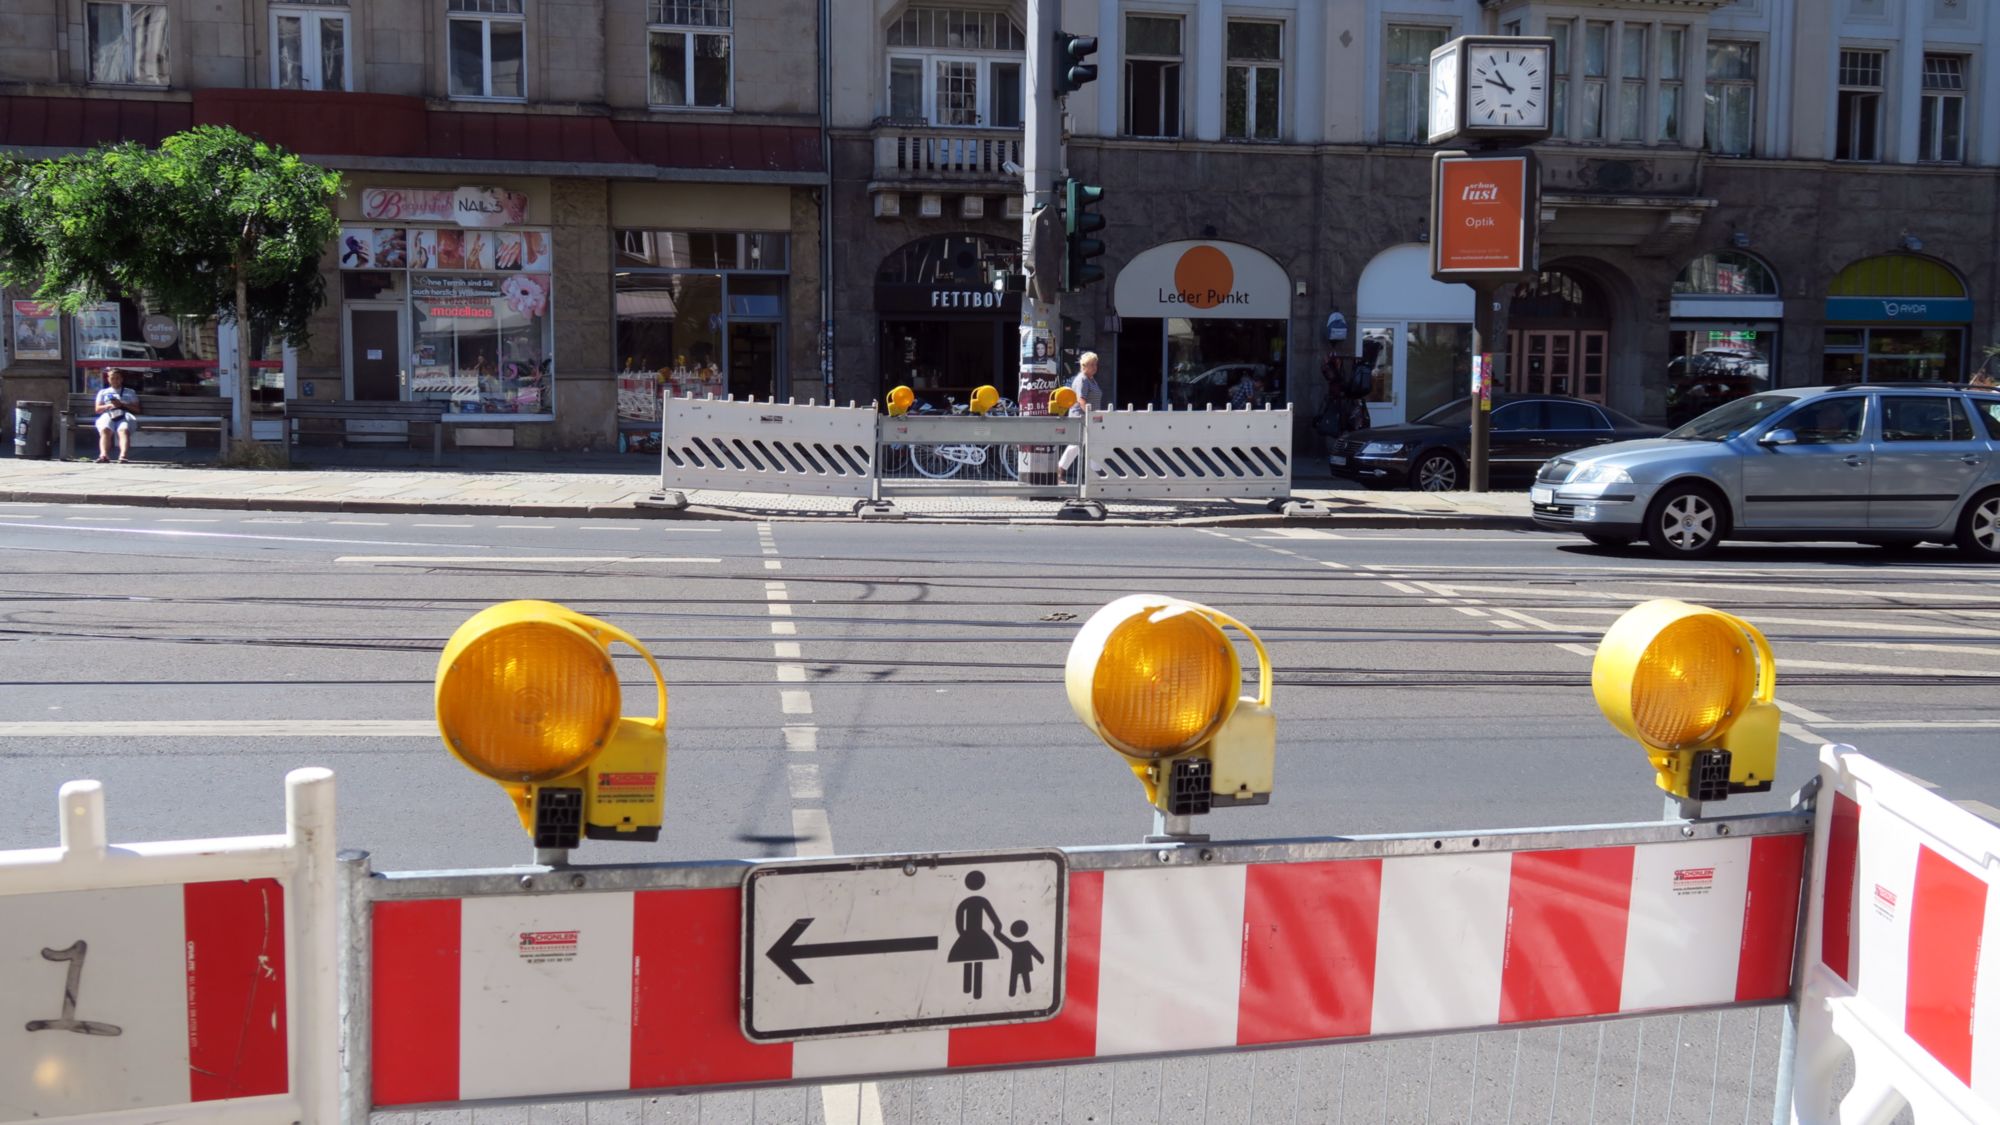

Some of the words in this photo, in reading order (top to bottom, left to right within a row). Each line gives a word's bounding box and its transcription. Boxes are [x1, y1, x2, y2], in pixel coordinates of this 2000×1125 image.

[1462, 186, 1499, 201] lust
[1465, 216, 1496, 229] Optik
[931, 291, 1004, 308] FETTBOY
[1159, 287, 1202, 304] Leder
[1206, 288, 1251, 305] Punkt
[1900, 303, 1928, 314] AYDA
[146, 323, 174, 332] Coffee
[160, 335, 172, 343] go
[25, 939, 123, 1037] 1
